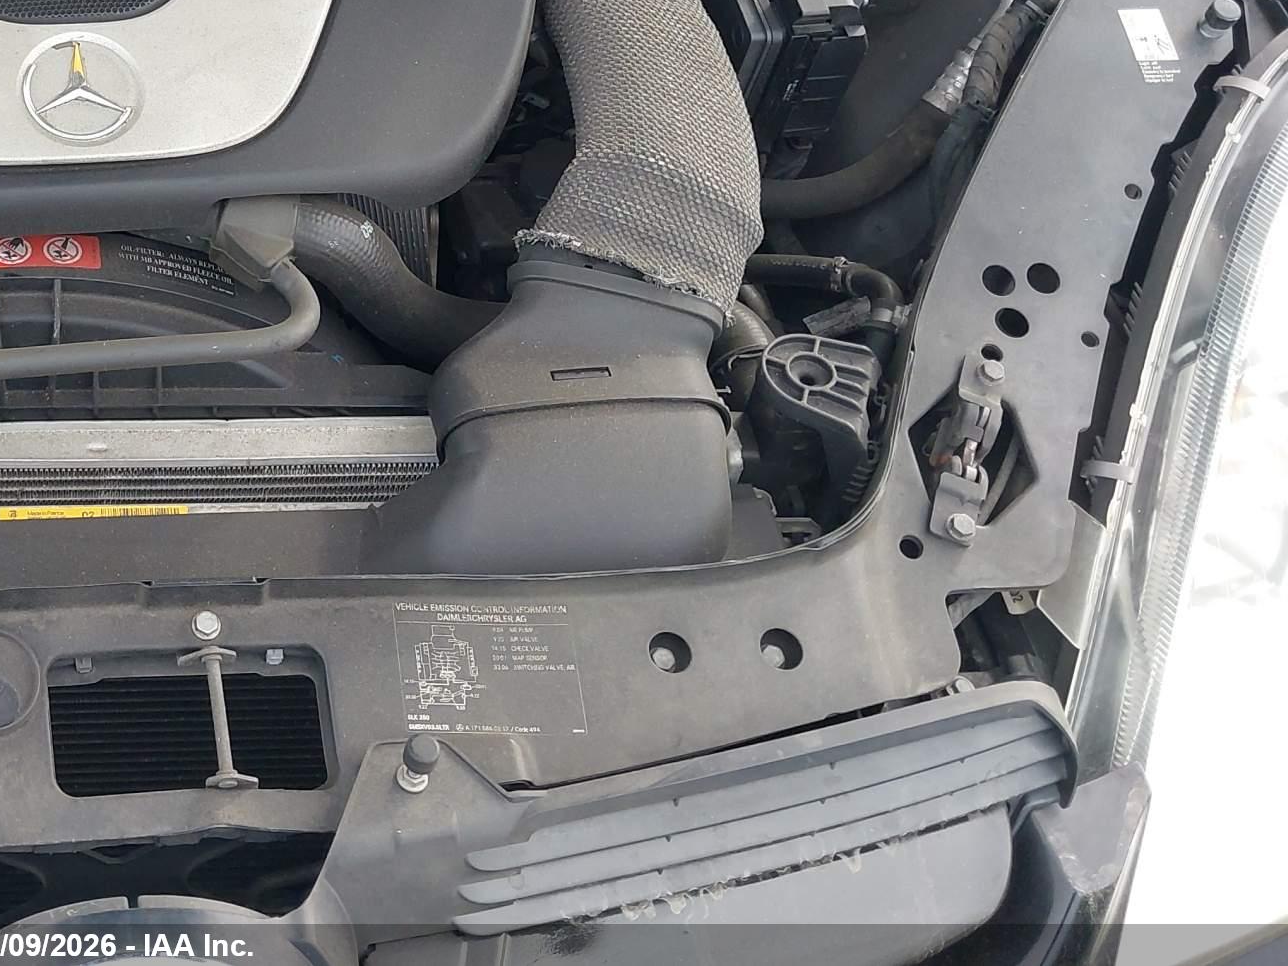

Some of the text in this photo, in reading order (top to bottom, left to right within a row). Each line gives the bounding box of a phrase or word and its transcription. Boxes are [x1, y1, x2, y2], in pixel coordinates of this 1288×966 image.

[118, 252, 139, 261] WITH
[154, 258, 192, 272] APPROVED
[168, 252, 198, 265] ALWAYS
[146, 265, 209, 286] FILTER ELEMENT
[395, 602, 567, 614] VEHICLE EMISSION CONTROL INFORMATION
[437, 613, 527, 623] DAIMLERCHRYSLER AG
